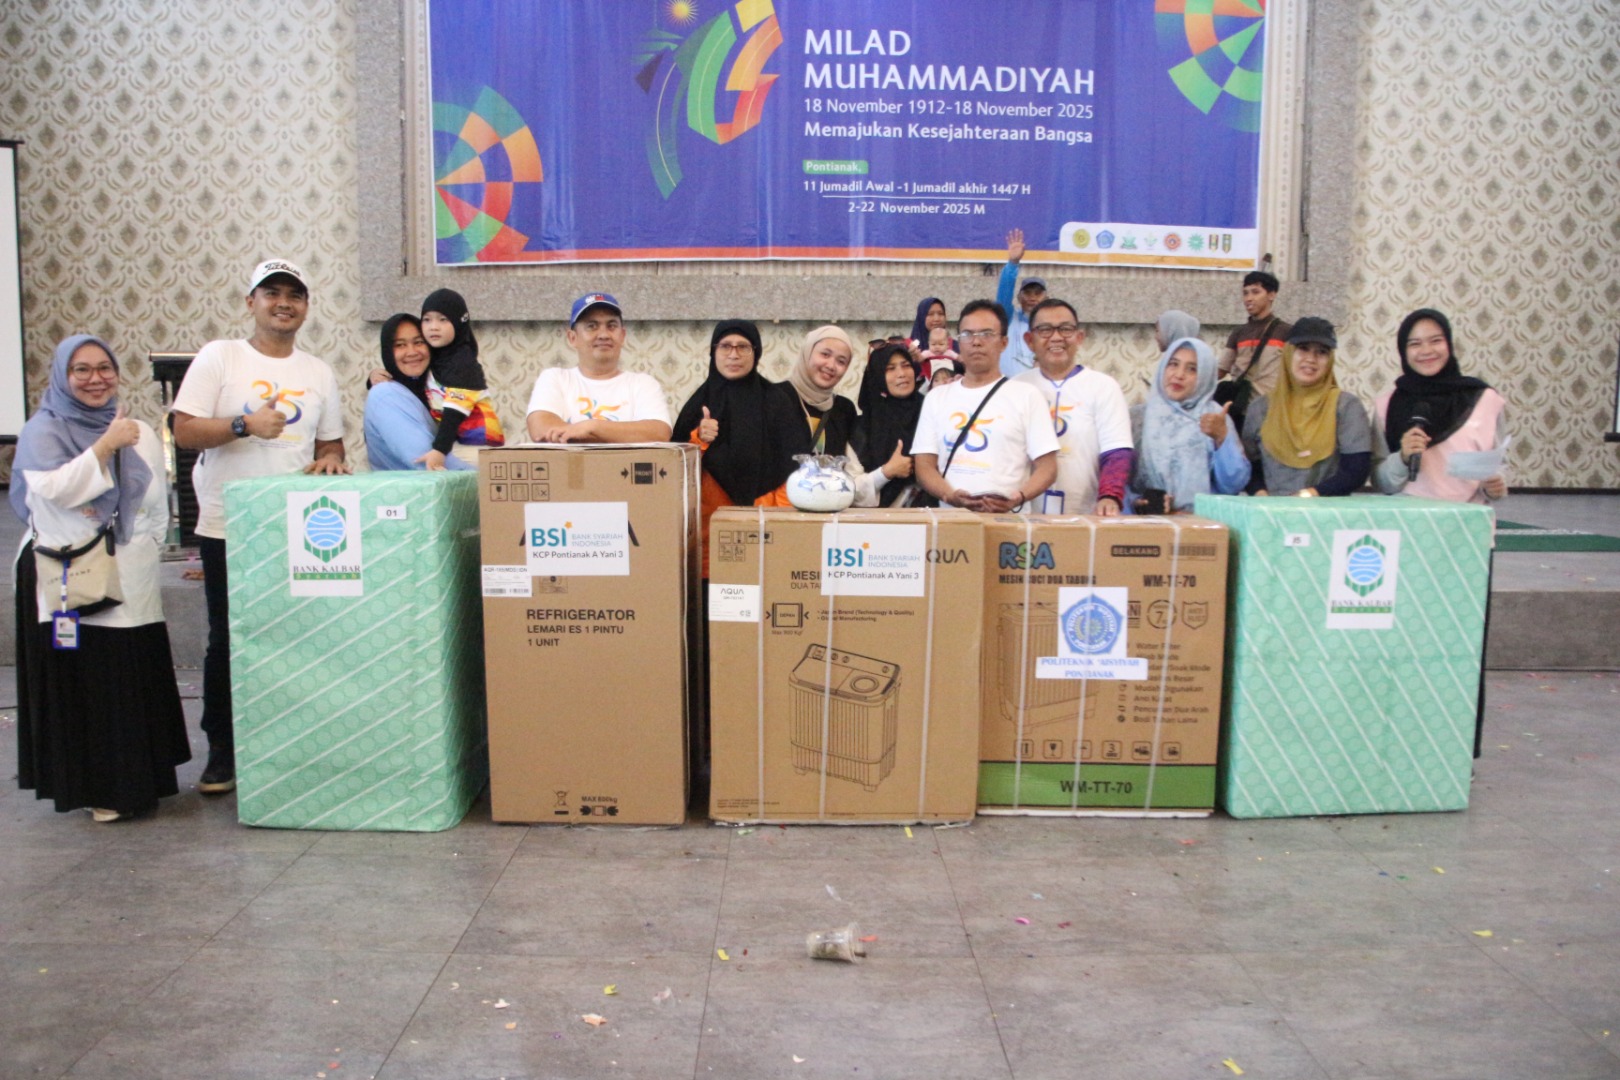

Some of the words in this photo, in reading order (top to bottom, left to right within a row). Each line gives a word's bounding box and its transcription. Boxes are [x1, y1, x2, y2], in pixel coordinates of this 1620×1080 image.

[803, 28, 912, 57] MILAD
[803, 63, 1095, 96] MUHAMMADIYAH
[804, 98, 823, 114] 18
[826, 99, 903, 115] November
[907, 100, 973, 117] 1912-18
[976, 101, 1053, 118] November
[1057, 103, 1094, 120] 2025
[803, 122, 903, 142] Memajukan
[907, 123, 1030, 145] Kesejahteraan
[1034, 126, 1093, 147] Bangsa
[803, 180, 817, 192] 11
[819, 181, 863, 195] Jumadil
[865, 181, 895, 193] Awal
[911, 182, 957, 196] Jumadil
[958, 182, 989, 195] akhir
[991, 183, 1019, 195] 1447
[1021, 184, 1031, 195] H
[848, 201, 876, 214] 2-22
[879, 202, 941, 215] November
[942, 203, 972, 215] 2025
[973, 204, 986, 215] M
[385, 508, 398, 518] 01
[531, 527, 567, 547] BSI
[571, 533, 592, 541] BANK
[593, 533, 623, 541] SYARIAH
[532, 551, 550, 559] KCP
[551, 550, 590, 559] Pontianak
[591, 551, 598, 559] A
[600, 551, 617, 559] Yani
[618, 550, 624, 559] 3
[827, 547, 864, 568] BSI
[868, 554, 888, 562] BANK
[889, 554, 921, 562] SYARIAH
[925, 548, 970, 565] QUA
[998, 541, 1056, 570] RSA
[293, 565, 319, 573] BANK
[321, 565, 361, 573] KALBAR
[791, 570, 821, 580] MESI
[846, 571, 886, 580] Pontianak
[790, 582, 810, 590] DUA
[811, 582, 821, 590] TA
[526, 608, 636, 621] REFRIGERATOR
[821, 609, 837, 617] Jan
[527, 625, 566, 634] LEMARI
[568, 625, 582, 634] ES
[585, 626, 590, 634] 1
[592, 626, 624, 635] PINTU
[528, 638, 533, 647] 1
[535, 638, 560, 647] UNIT
[1059, 779, 1133, 794] WM-TT-70
